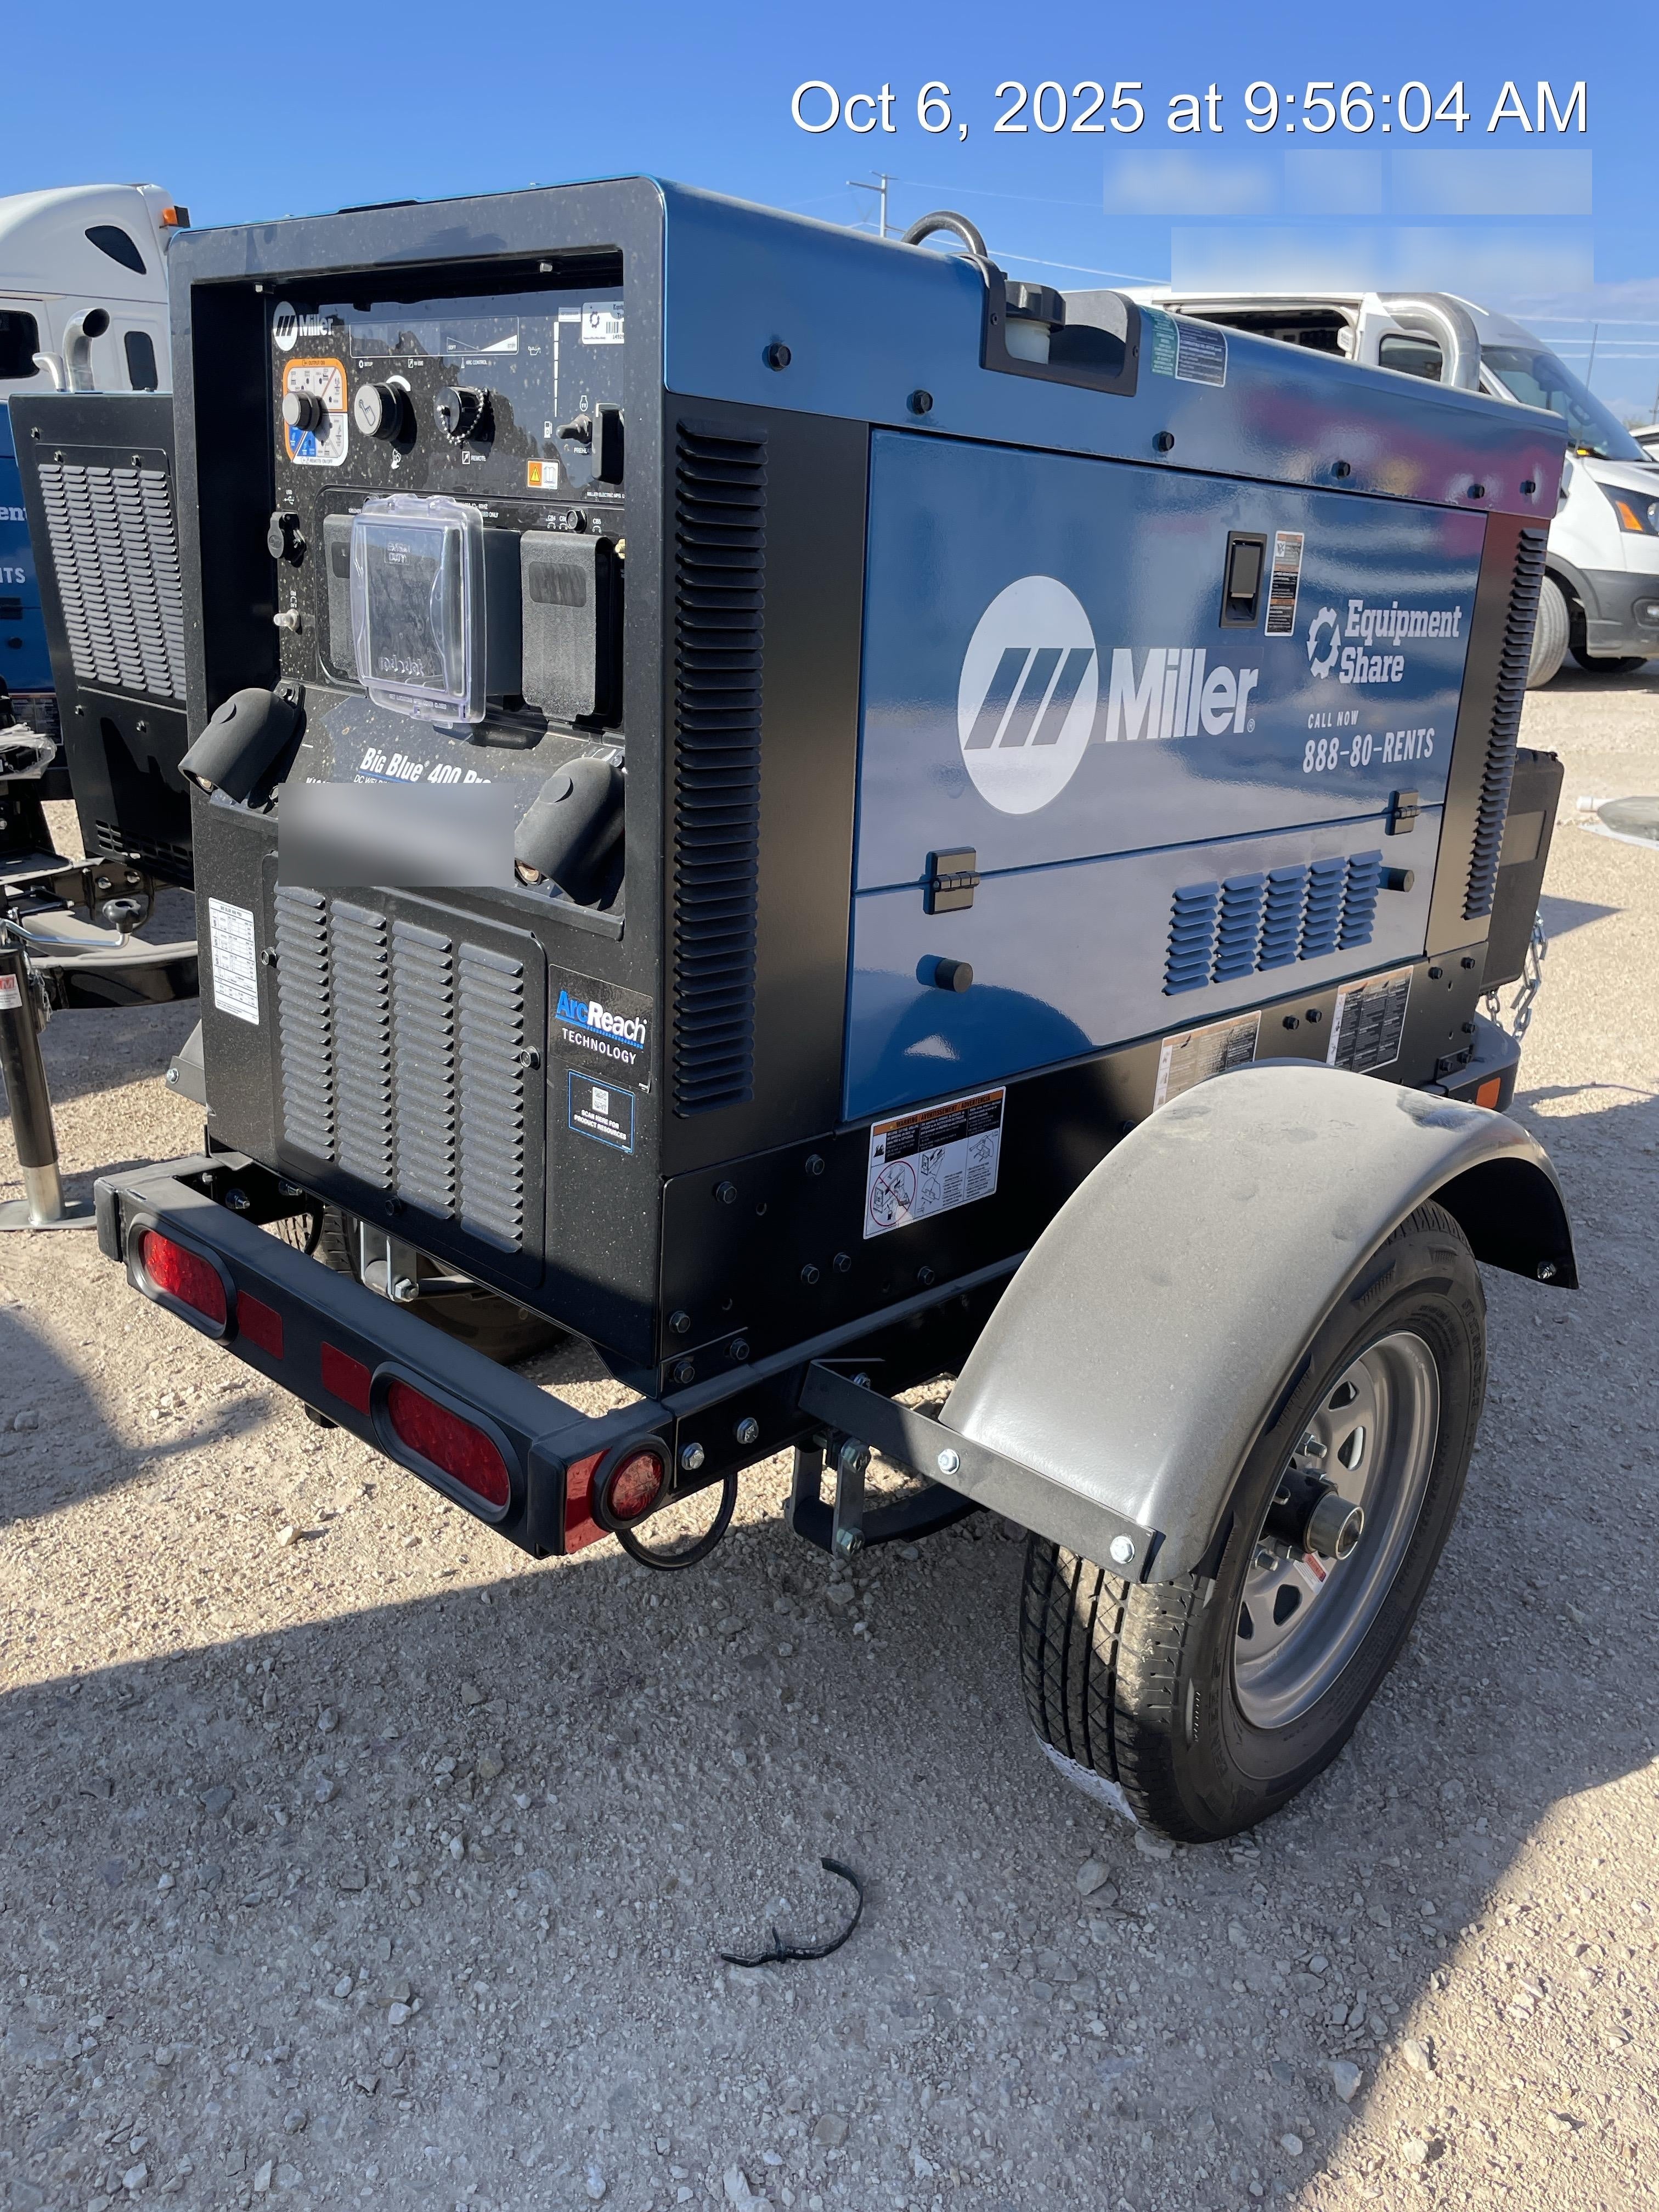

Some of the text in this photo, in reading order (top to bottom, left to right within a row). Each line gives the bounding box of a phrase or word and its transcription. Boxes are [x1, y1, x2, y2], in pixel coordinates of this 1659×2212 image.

[298, 314, 334, 337] Miller
[1344, 599, 1463, 646] Equipment
[1338, 647, 1405, 684] Share
[1105, 647, 1259, 742] Miller
[1307, 710, 1359, 729] CALL NOW
[1302, 727, 1435, 774] 888-80-RENTS
[385, 753, 424, 782] Blue
[427, 763, 462, 783] 400
[556, 990, 647, 1045] ArcReach
[562, 1028, 637, 1065] TECHNOLOGY
[574, 1114, 627, 1140] PRODUCT RESOURCES
[581, 1109, 619, 1130] SCAN HERE FOR
[896, 1115, 918, 1127] WARNING
